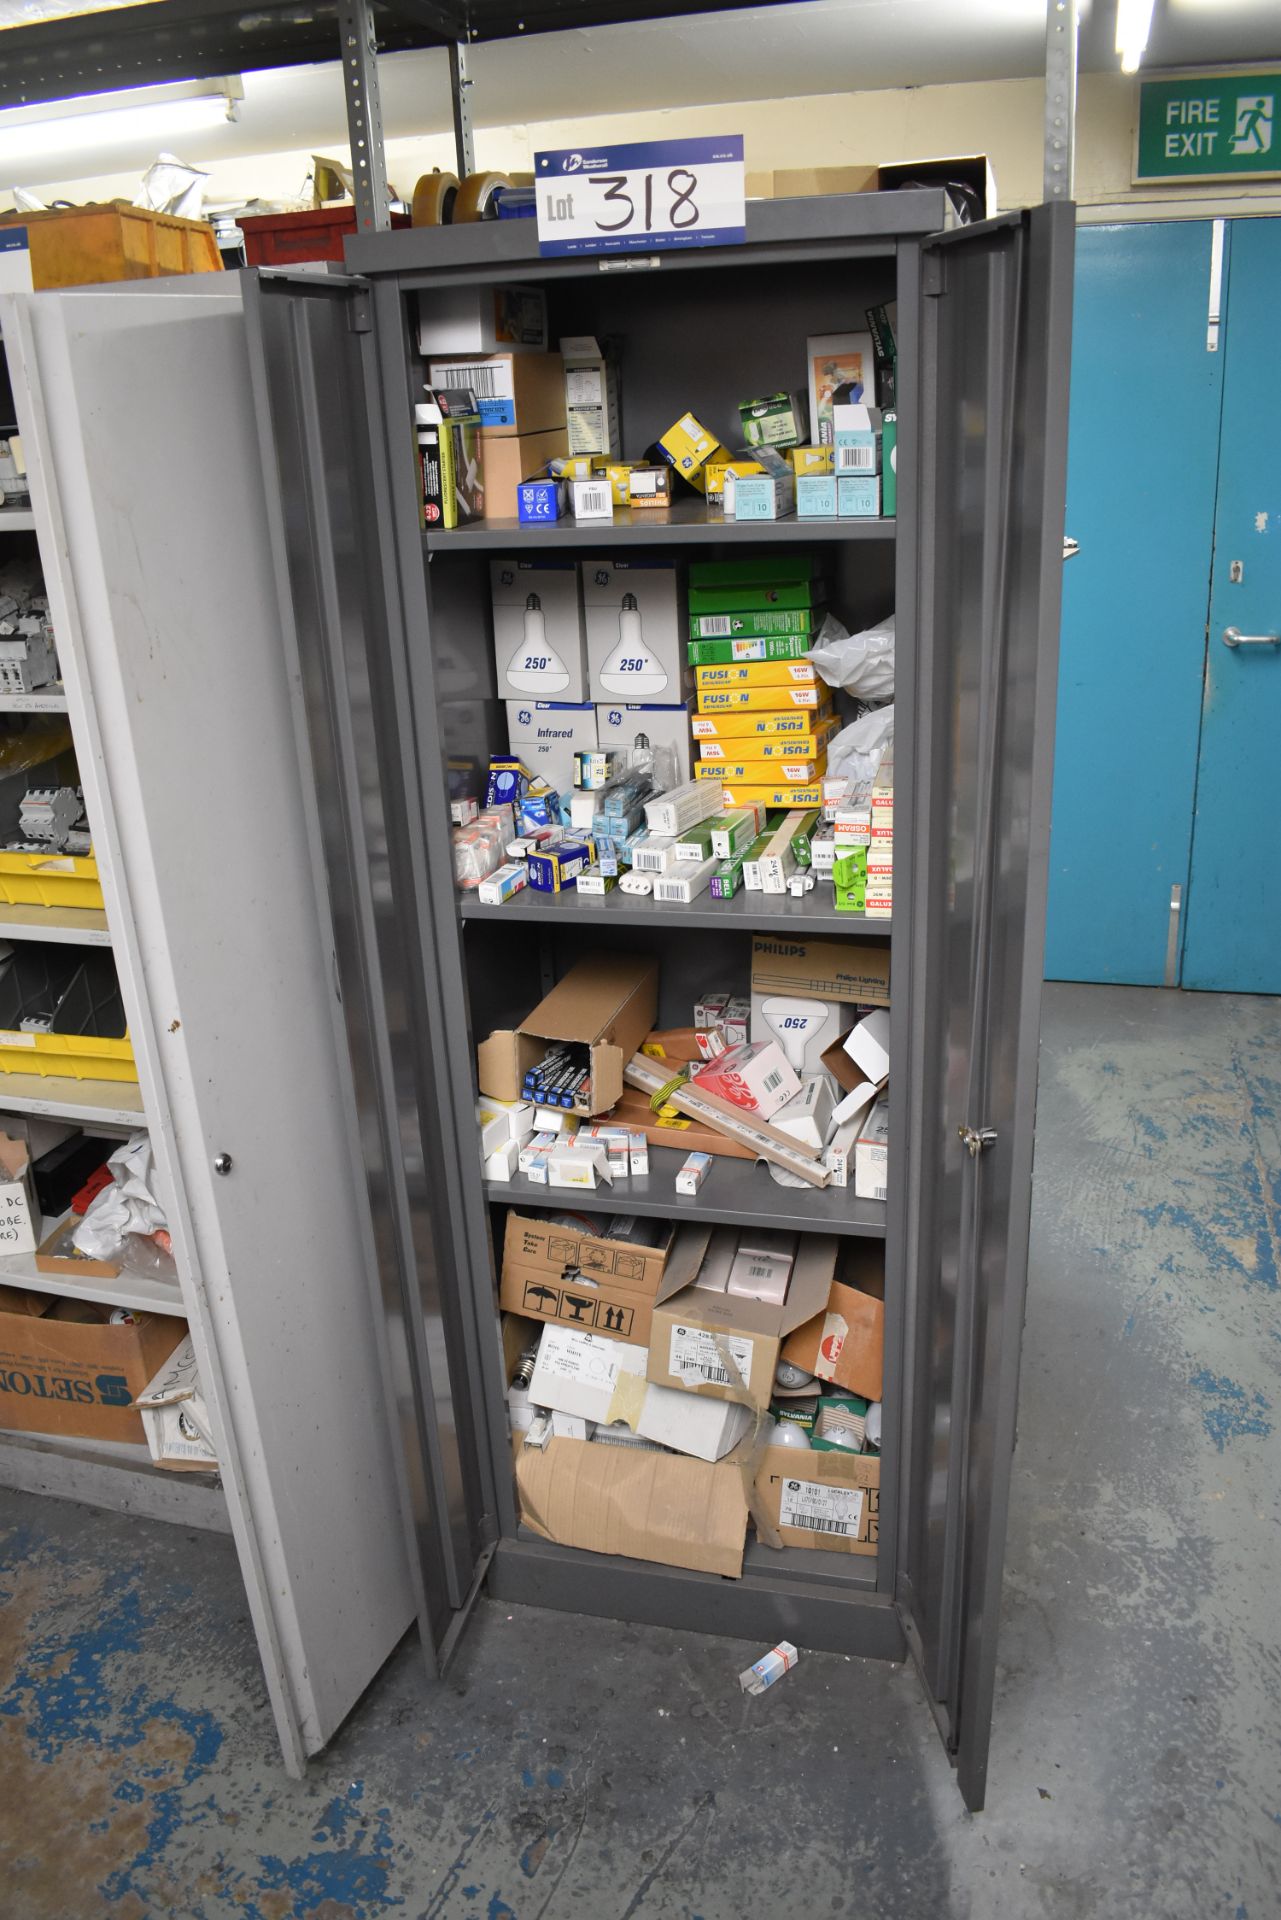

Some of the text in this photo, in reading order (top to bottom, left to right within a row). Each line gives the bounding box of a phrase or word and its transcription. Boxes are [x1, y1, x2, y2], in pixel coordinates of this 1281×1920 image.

[1166, 99, 1220, 125] FIRE
[1165, 132, 1218, 157] EXIT
[588, 169, 700, 232] 318
[546, 193, 575, 222] Lot
[639, 499, 668, 507] PHILIPS
[757, 503, 767, 512] 10
[820, 500, 830, 508] 10
[860, 500, 870, 508] 10
[701, 668, 748, 680] FUSION
[703, 693, 750, 704] FUSION
[756, 721, 803, 731] FUSION
[537, 727, 573, 739] Infrared
[763, 746, 810, 756] FUSION
[700, 766, 744, 776] FUSION
[773, 793, 819, 803] FUSION
[838, 824, 867, 832] OSRAM
[770, 860, 778, 876] 24W
[723, 878, 731, 897] BELL
[753, 942, 806, 957] PHILIPS
[836, 973, 886, 986] Philips Lighting
[5, 1196, 24, 1207] DC
[523, 1239, 538, 1248] Take
[522, 1246, 537, 1255] Care
[779, 1410, 813, 1421] SYLVANIA
